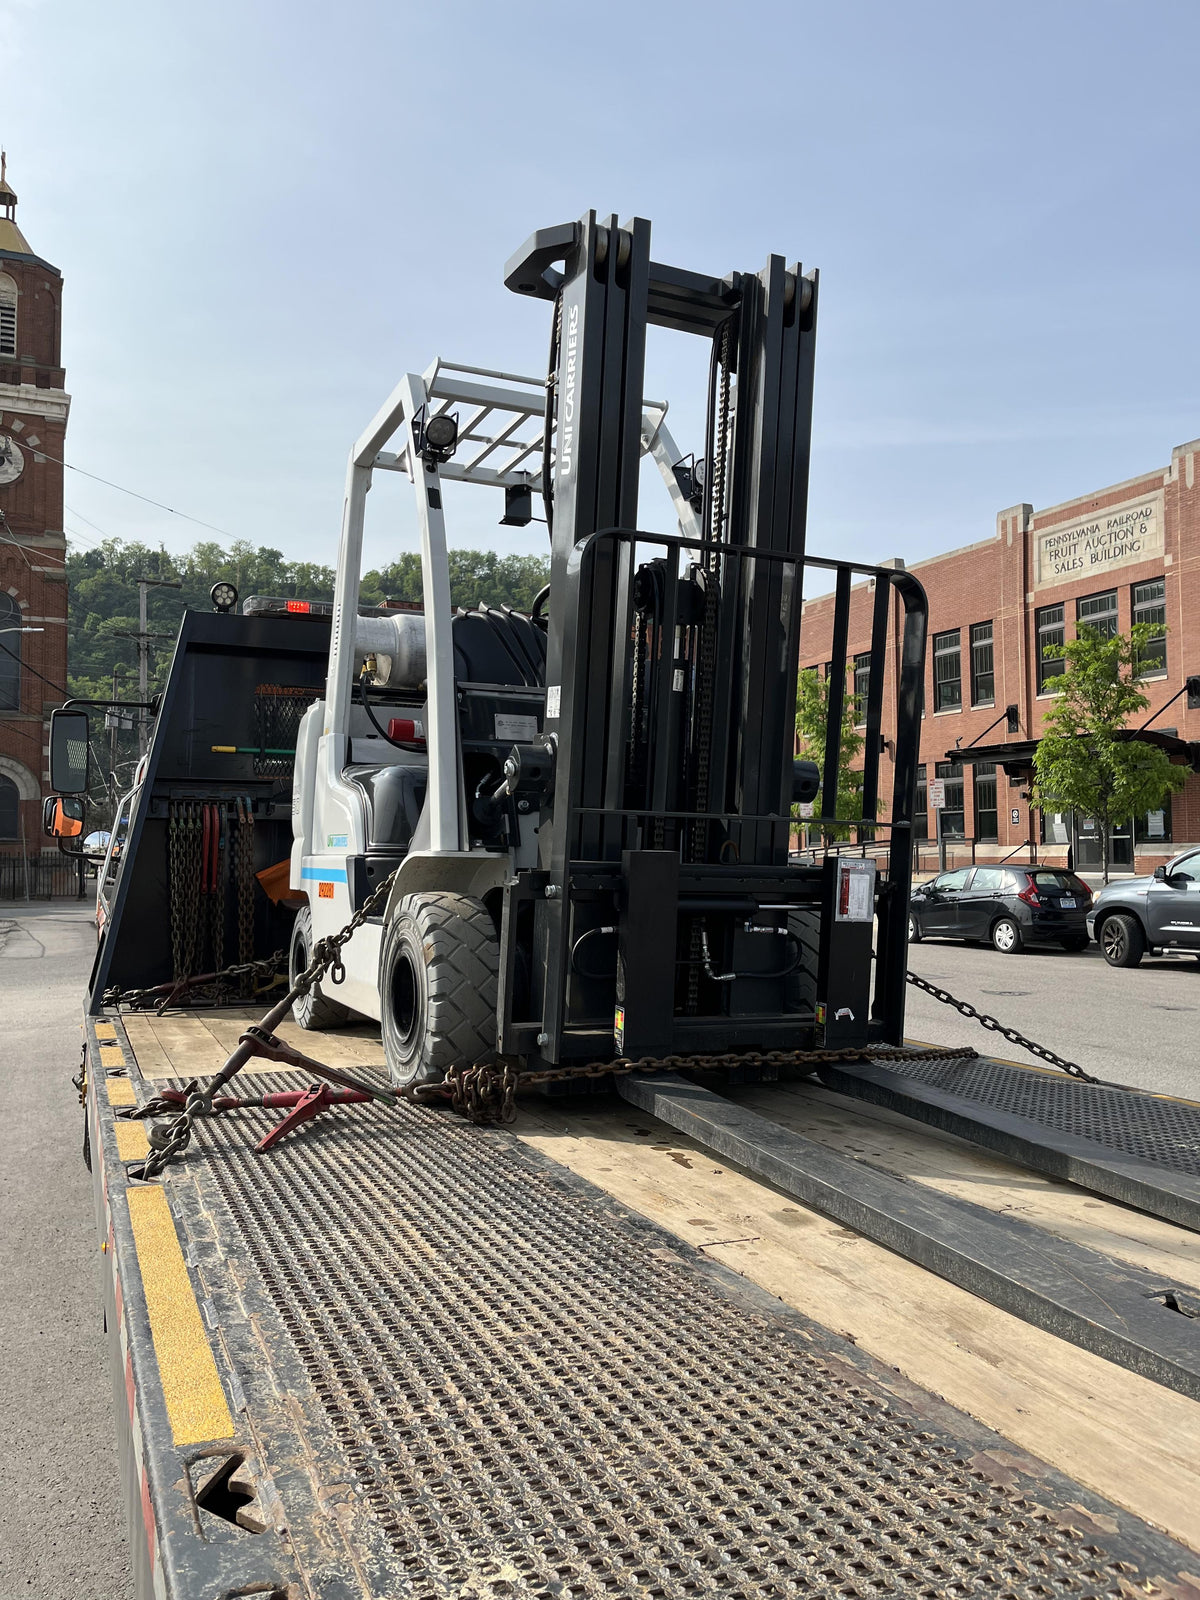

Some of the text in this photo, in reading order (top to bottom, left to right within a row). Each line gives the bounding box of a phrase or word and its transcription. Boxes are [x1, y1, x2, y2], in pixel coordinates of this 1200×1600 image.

[561, 304, 579, 475] UNICARRIERS
[1045, 508, 1152, 549] PENNSYLVANIA RAILROAD
[1049, 523, 1148, 561] FRUIT AUCTION &
[1054, 540, 1141, 574] SALES BUILDING
